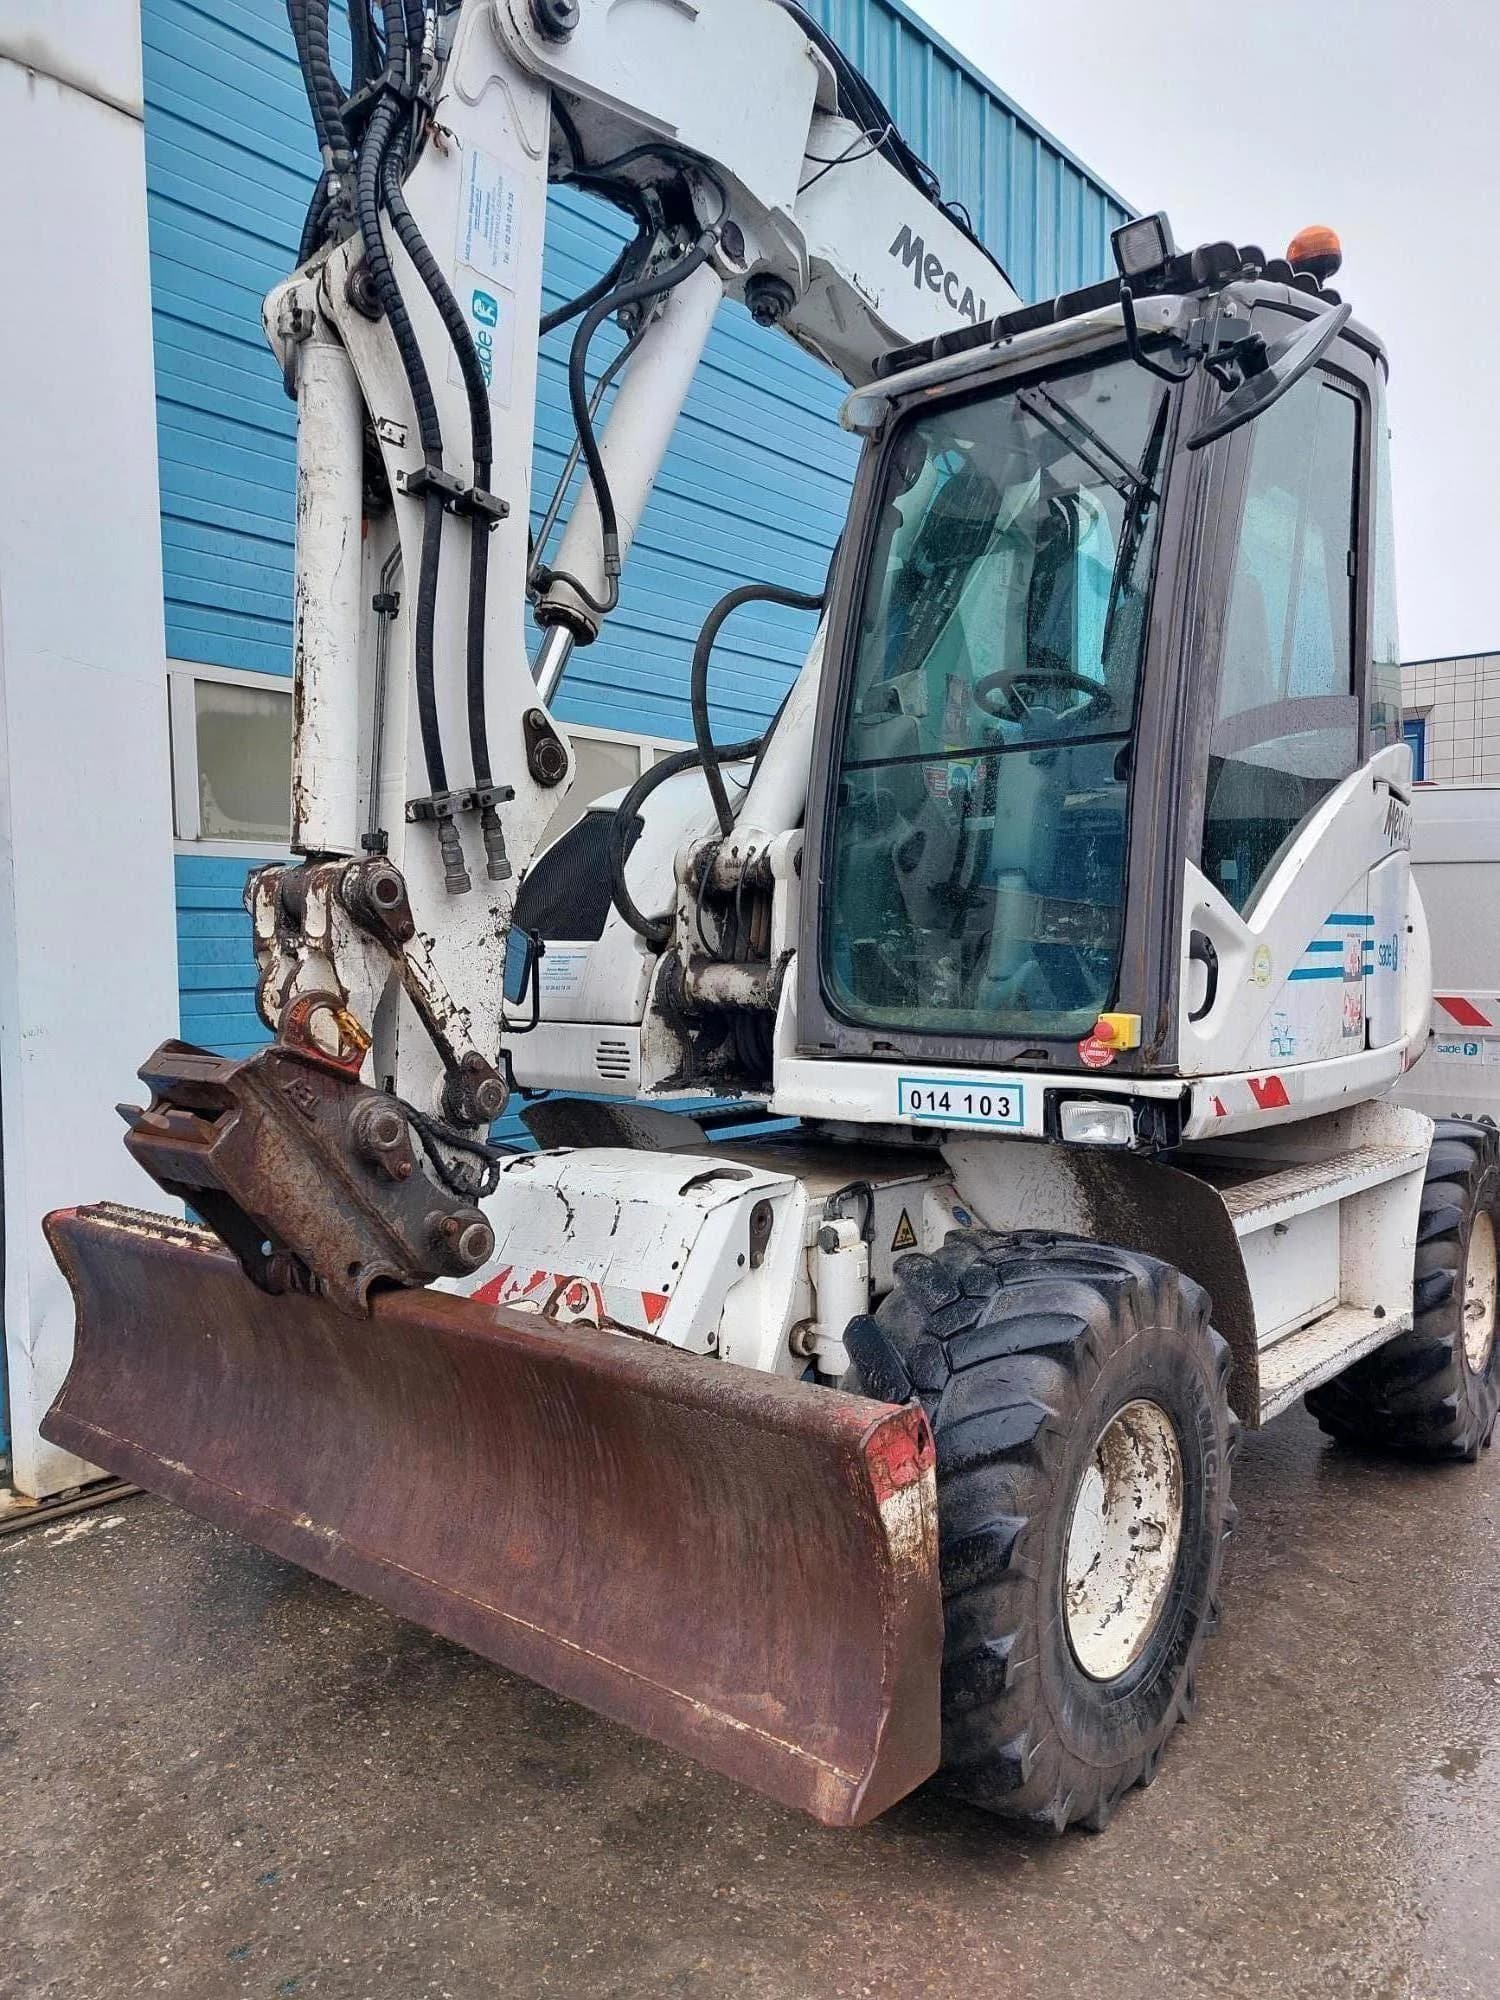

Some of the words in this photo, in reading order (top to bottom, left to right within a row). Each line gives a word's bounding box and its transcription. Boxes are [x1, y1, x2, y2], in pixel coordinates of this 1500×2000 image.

[1437, 1044, 1461, 1054] sade
[911, 1090, 951, 1111] 014
[964, 1094, 1010, 1117] 103
